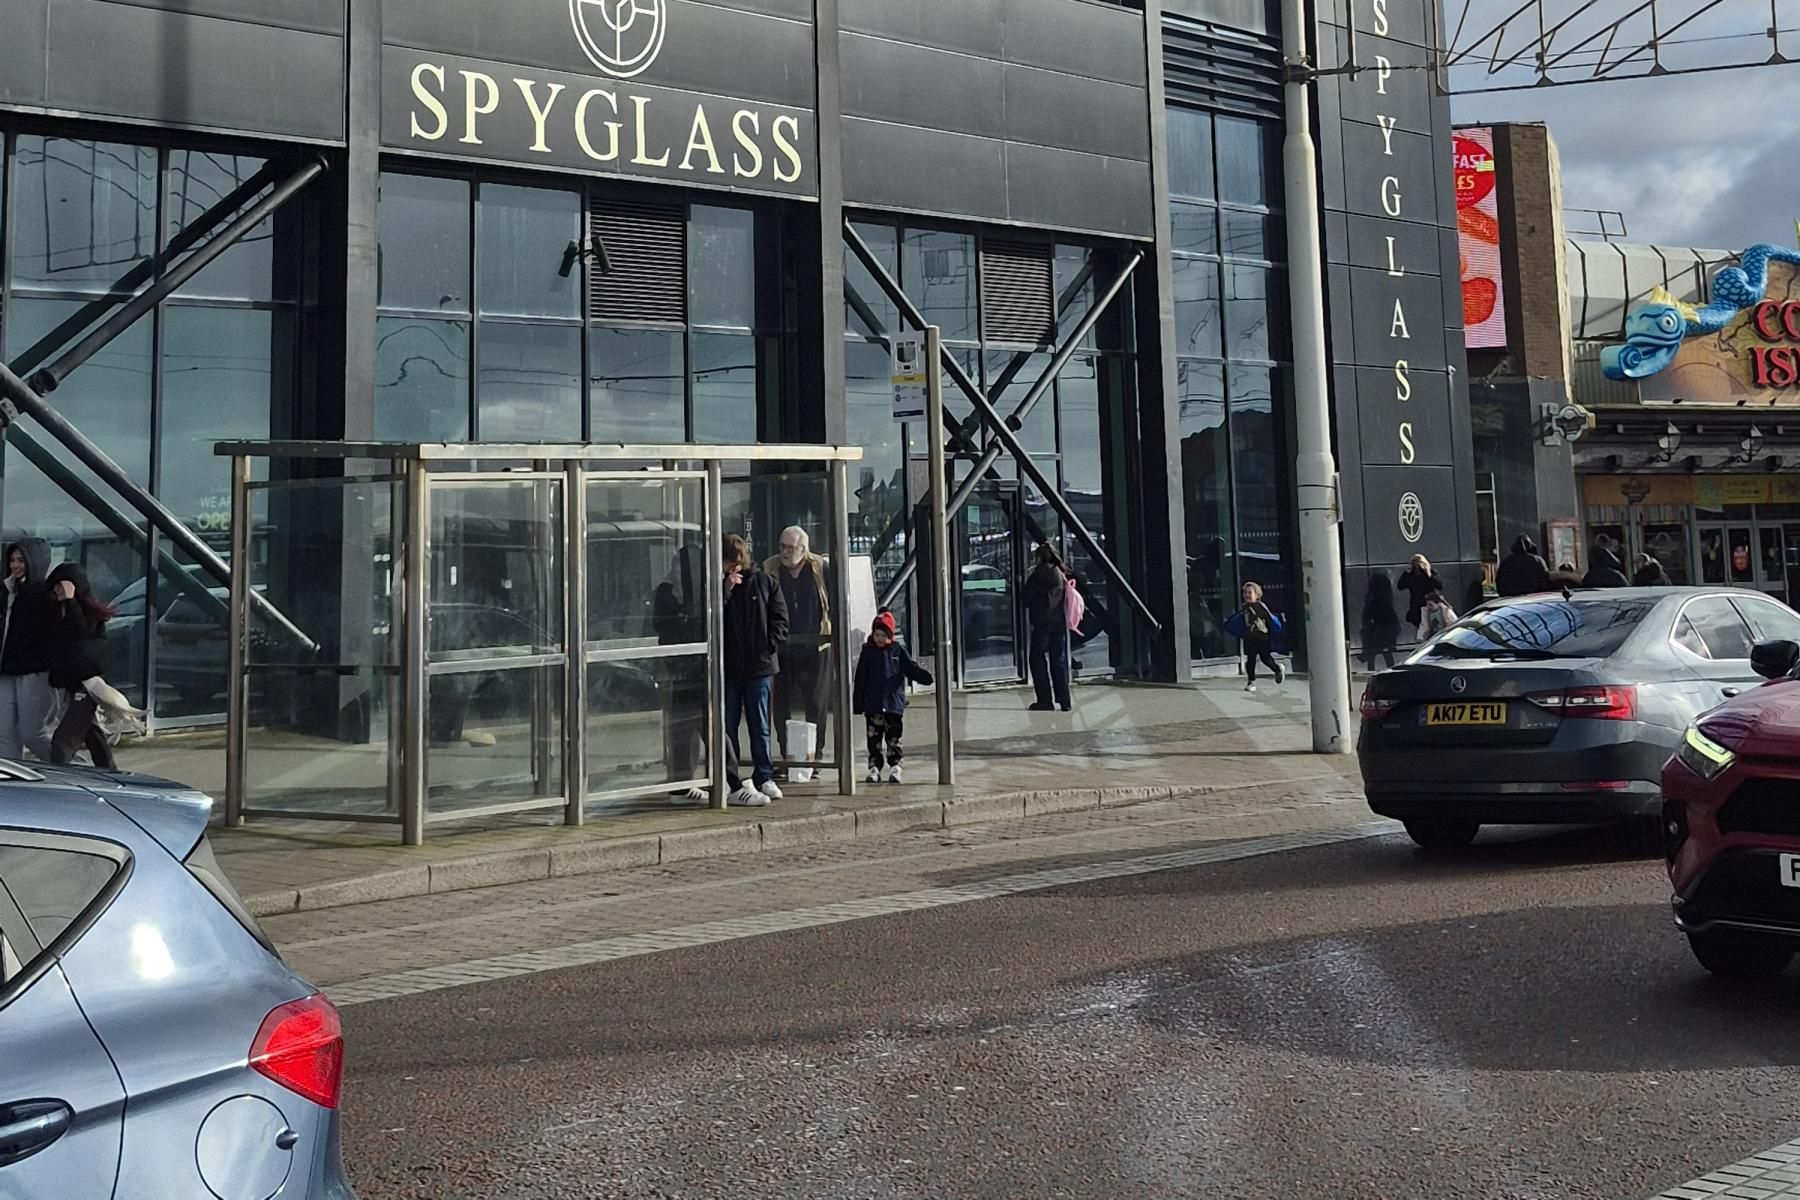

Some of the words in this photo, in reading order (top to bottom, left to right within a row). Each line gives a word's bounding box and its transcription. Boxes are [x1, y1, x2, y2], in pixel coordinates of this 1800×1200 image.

[410, 62, 802, 183] SPYGLASS
[1456, 175, 1475, 190] £5
[1751, 345, 1800, 387] IS
[200, 496, 217, 508] WE
[197, 511, 232, 531] OPE
[1431, 704, 1466, 722] AK17
[1469, 704, 1501, 721] ETU
